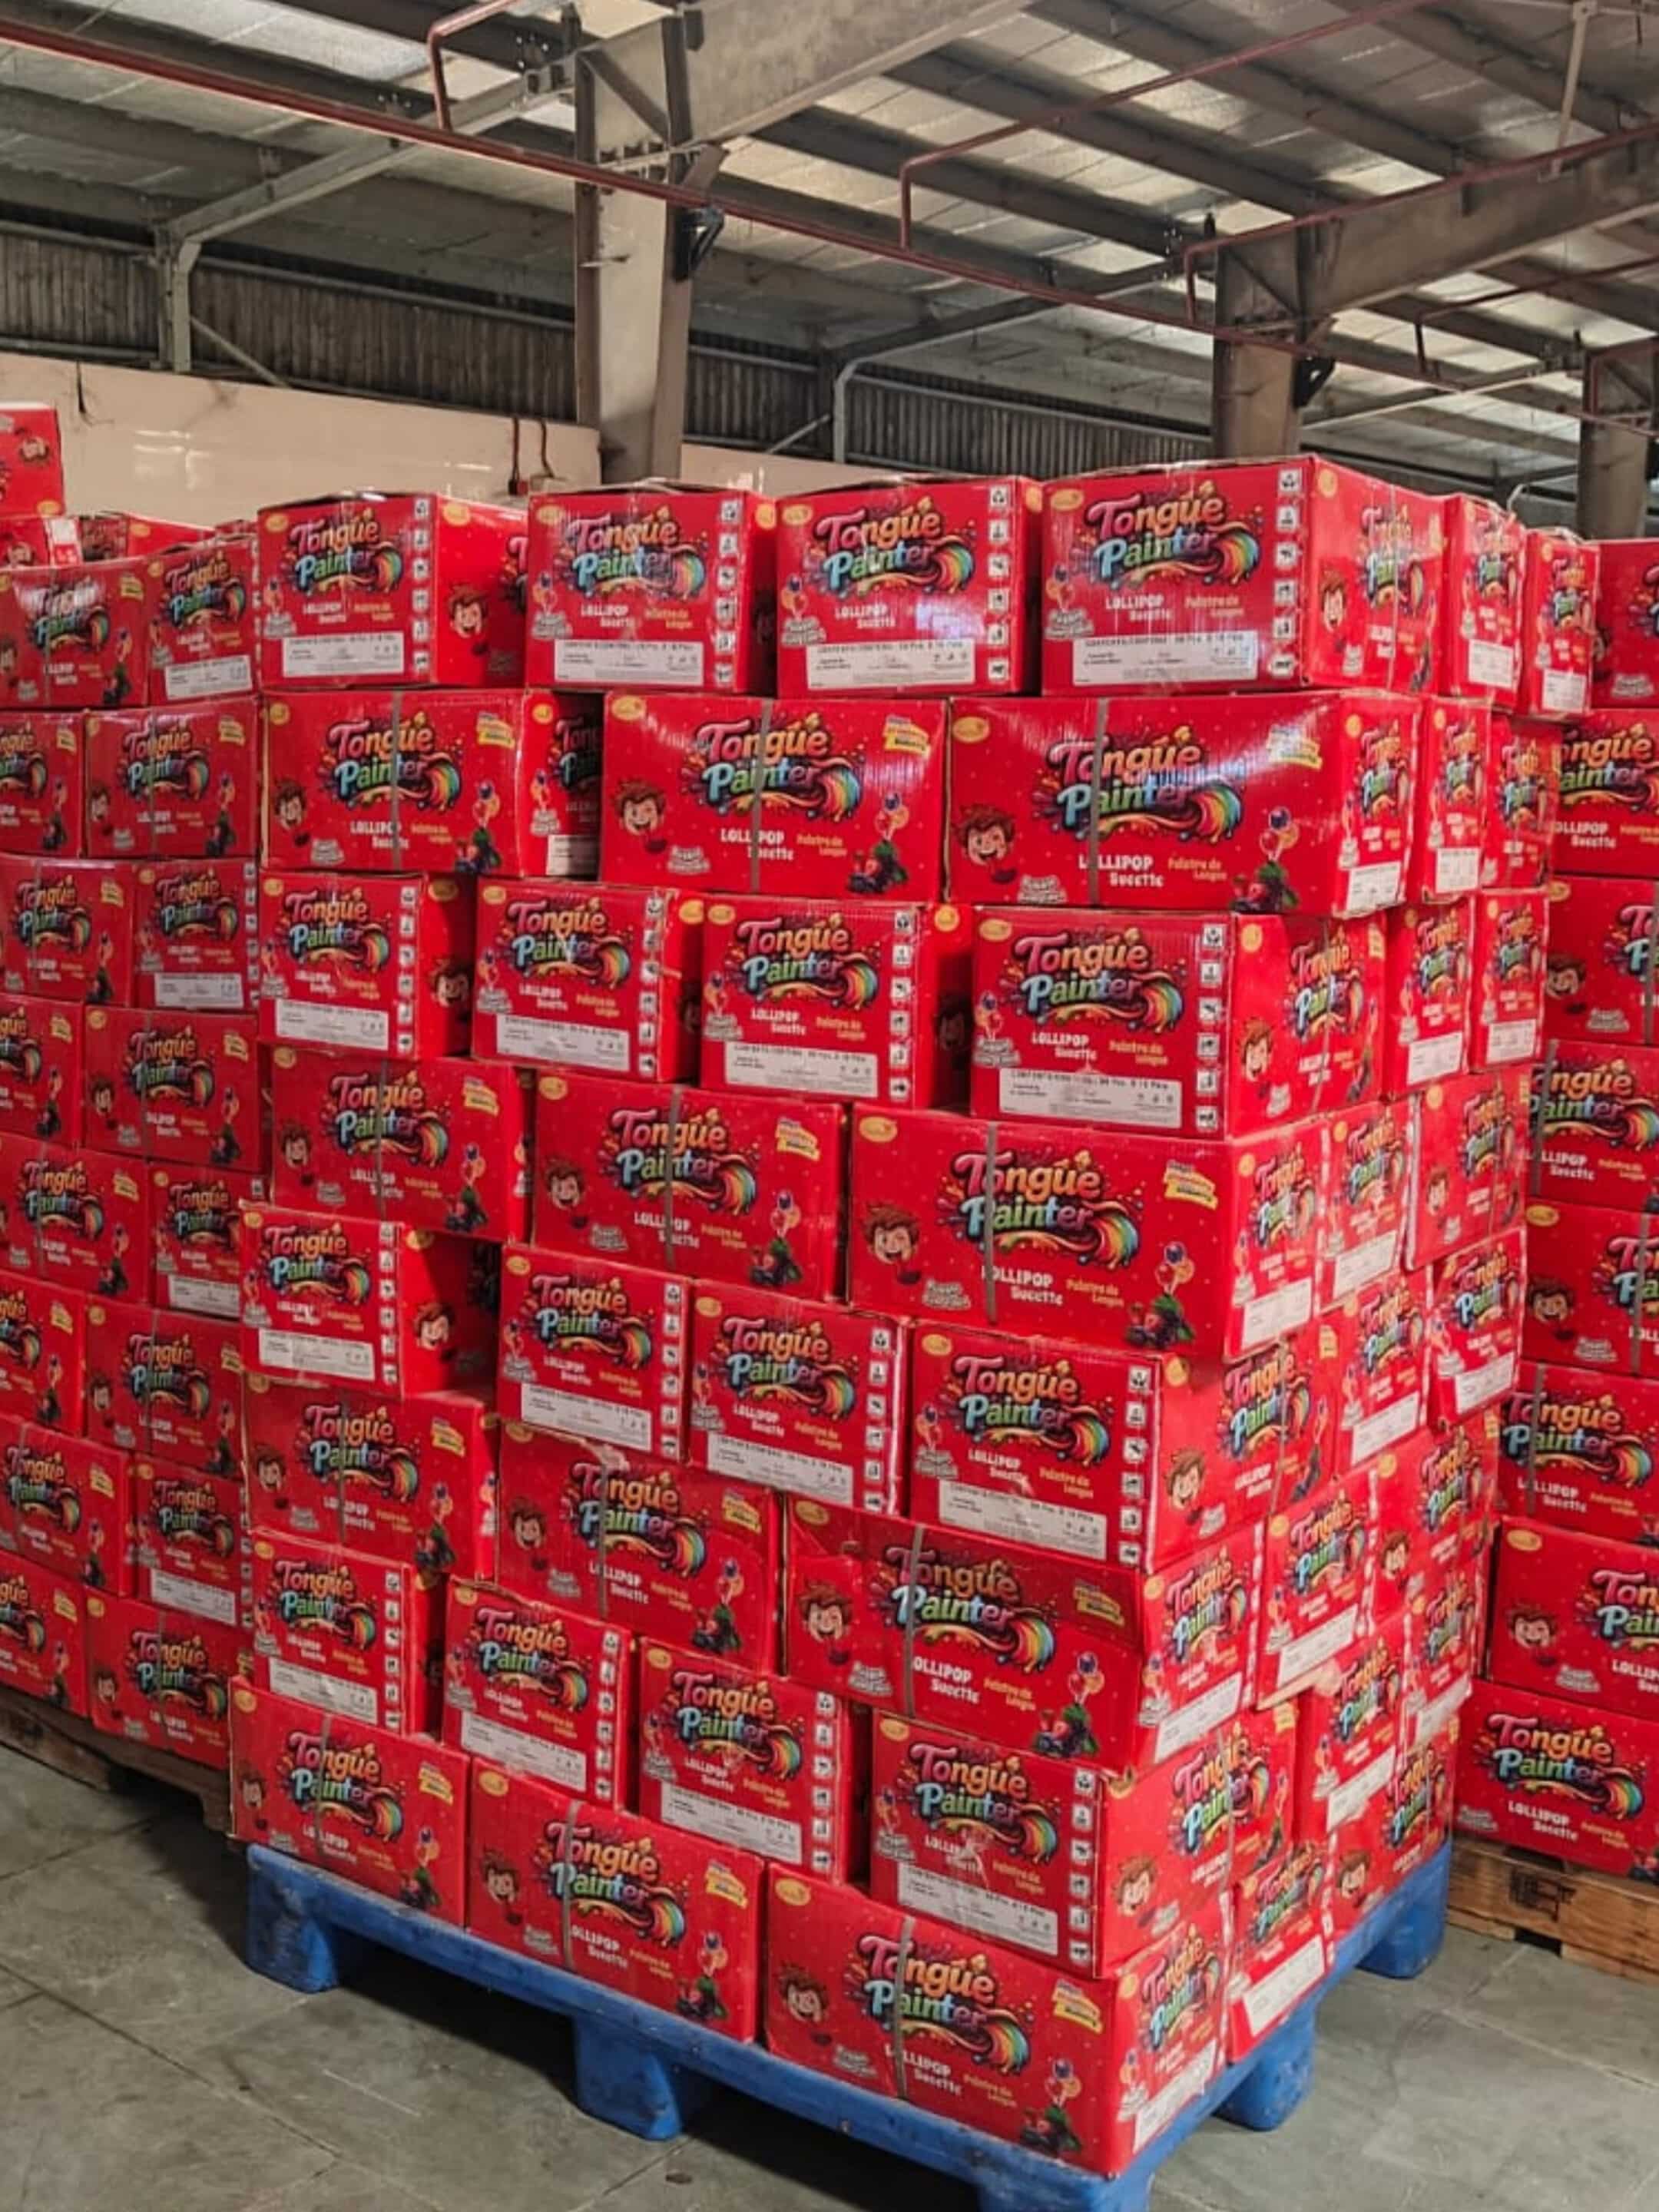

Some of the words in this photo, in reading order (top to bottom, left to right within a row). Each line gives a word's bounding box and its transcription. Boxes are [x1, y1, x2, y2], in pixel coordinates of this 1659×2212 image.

[568, 514, 677, 555] Tongue
[816, 509, 941, 555] Tongue
[1088, 493, 1224, 541] Tongue
[290, 518, 379, 558] Tongue
[1093, 527, 1217, 578] Painter
[294, 545, 374, 588] Painter
[571, 546, 671, 588] Painter
[823, 540, 935, 588] Painter
[836, 601, 889, 618] LOLLIPOP
[1105, 594, 1164, 611] LOLLIPOP
[1561, 761, 1646, 801] ainter
[1056, 776, 1194, 827] Painter
[720, 828, 785, 844] LOLLPOP
[1078, 854, 1154, 870] LLLIPOP
[156, 875, 220, 907] Tongue
[285, 890, 367, 927] Tongue
[288, 922, 363, 954] Painter
[508, 899, 605, 939] Tongue
[737, 917, 849, 959] Tongue
[512, 933, 601, 967] Painter
[1015, 932, 1148, 977] Tongue
[742, 952, 843, 990] Painter
[1020, 970, 1141, 1012] Painter
[751, 1008, 800, 1024] LOLLIPOP
[1031, 1031, 1090, 1048] LOLLIPOP
[263, 1224, 347, 1260] Tongue
[268, 1255, 344, 1286] Painter
[531, 1275, 627, 1316] Tongue
[535, 1308, 622, 1339] Painter
[723, 1318, 828, 1362] Tongue
[726, 1353, 823, 1386] Painter
[955, 1357, 1078, 1403] Tongue
[733, 1404, 780, 1424] LOLLIPOP
[959, 1395, 1071, 1430] Painter
[968, 1449, 1021, 1469] LOLLIPOP
[1502, 1425, 1614, 1455] Painter
[276, 1560, 354, 1599] Tongue
[279, 1590, 351, 1620] Painter
[477, 1608, 567, 1656] Tongue
[478, 1641, 561, 1678] Painter
[912, 1656, 972, 1682] OLLIPOP
[673, 1671, 774, 1720] Tongue
[676, 1706, 769, 1744] Painter
[1488, 1714, 1611, 1762] Tongue
[288, 1732, 379, 1782] Tongue
[911, 1743, 1027, 1798] Tongue
[1492, 1747, 1605, 1786] Painter
[915, 1781, 1021, 1824] Painter
[1508, 1800, 1570, 1826] LOLLIPOP
[864, 1978, 987, 2031] Painter
[884, 2044, 954, 2084] LLLIPOP
